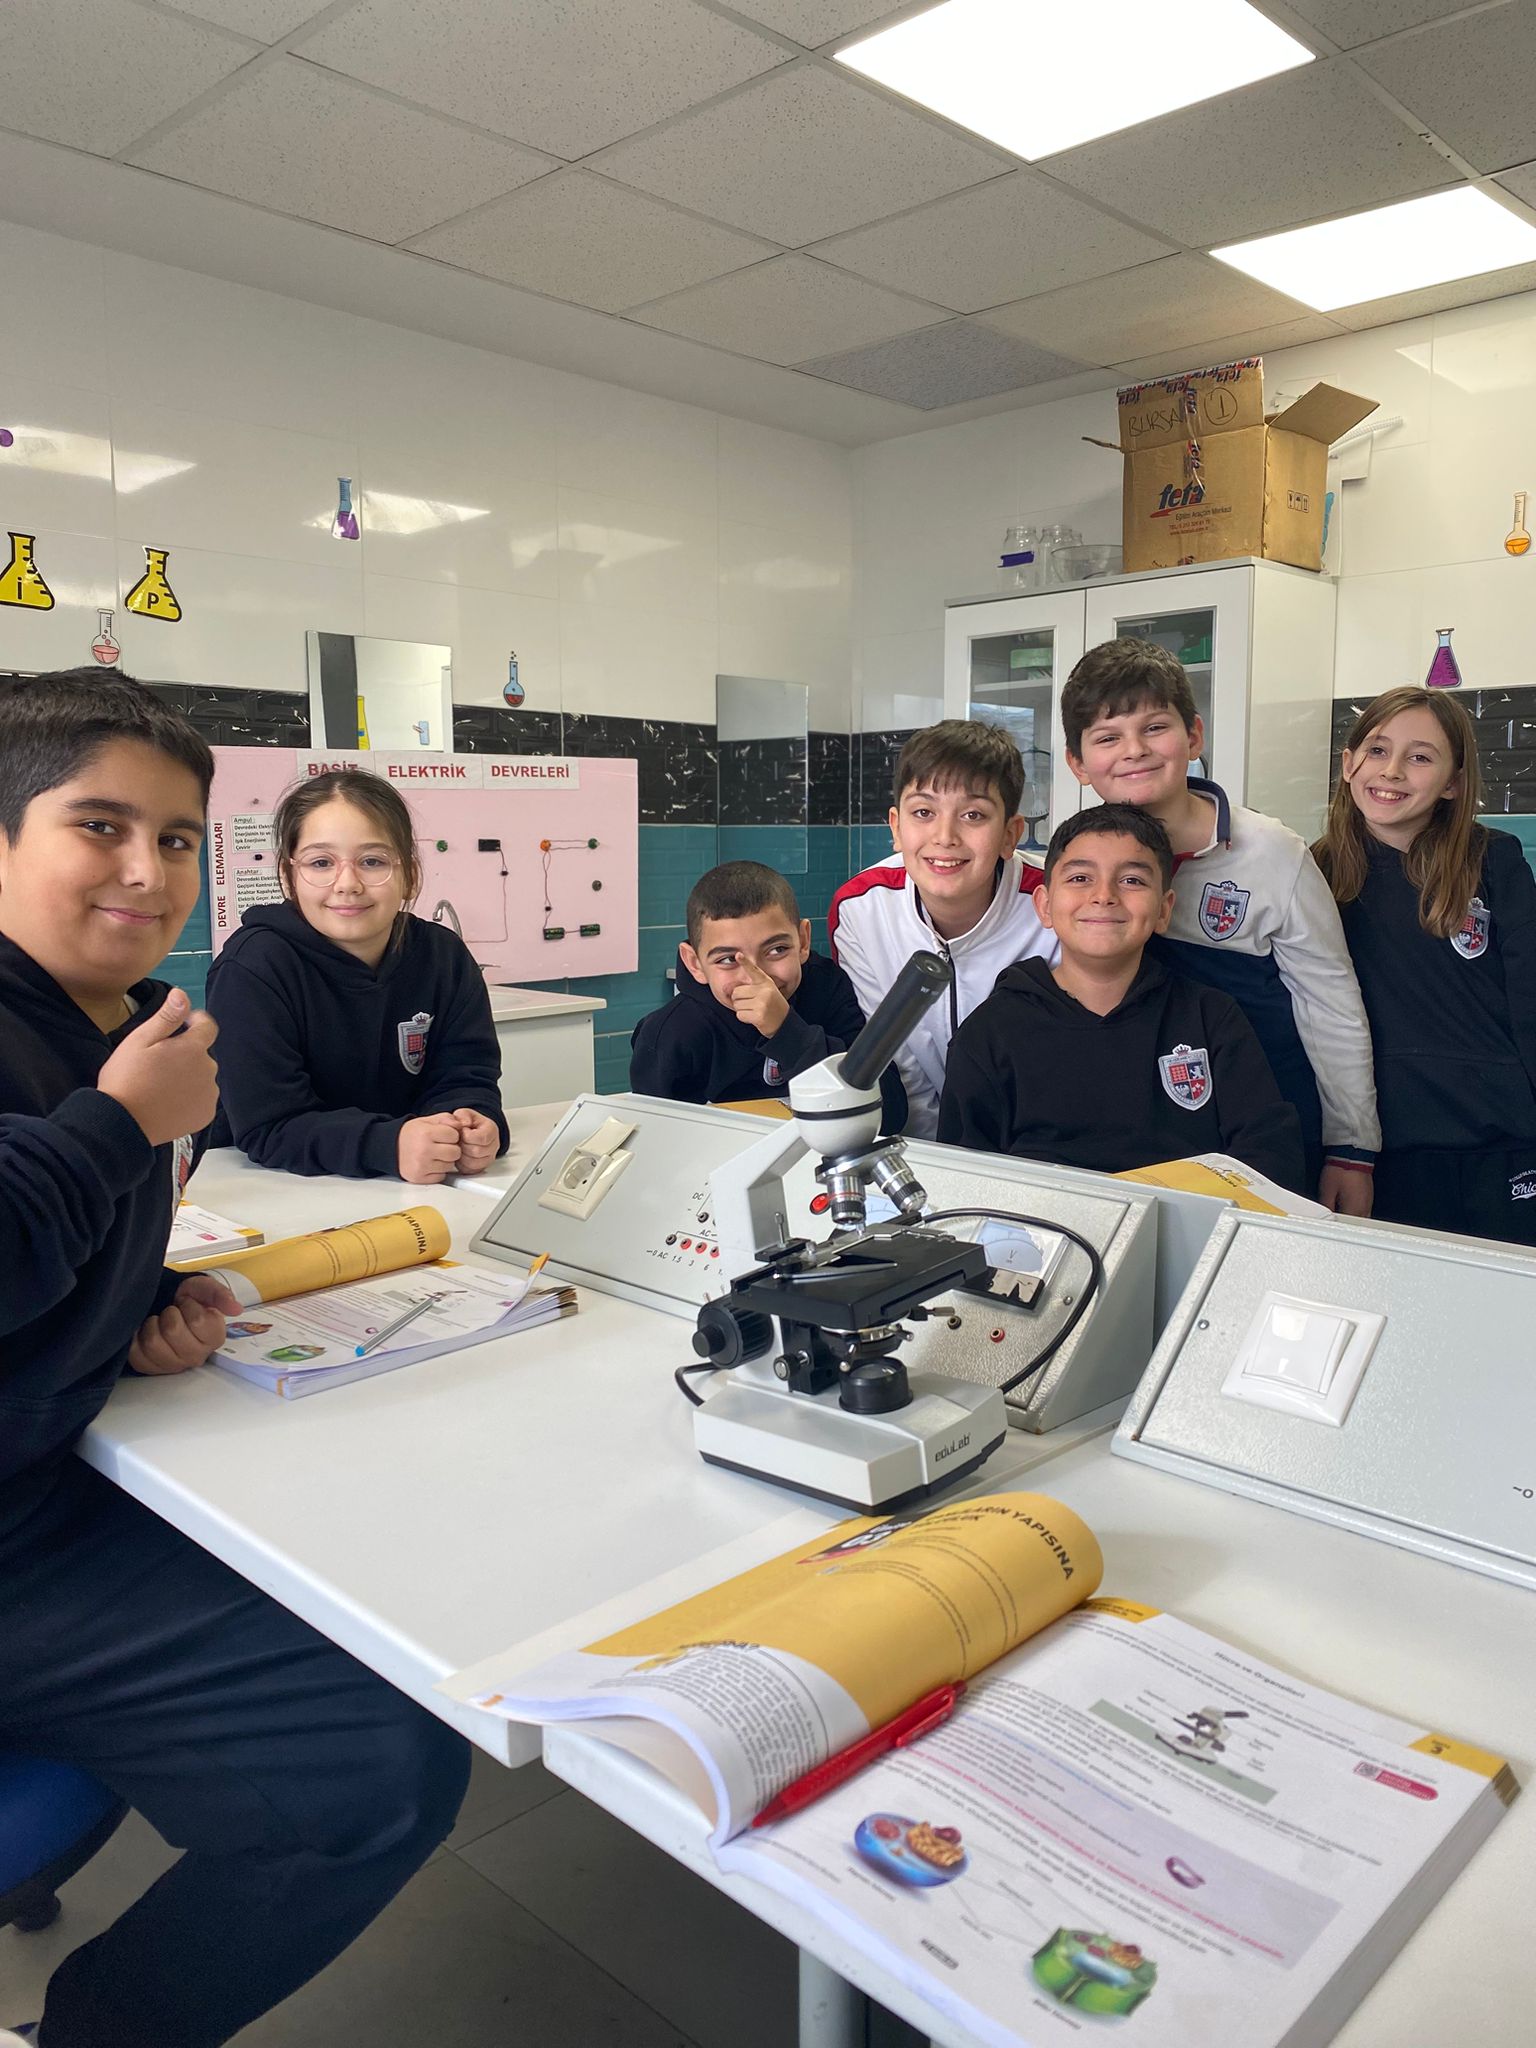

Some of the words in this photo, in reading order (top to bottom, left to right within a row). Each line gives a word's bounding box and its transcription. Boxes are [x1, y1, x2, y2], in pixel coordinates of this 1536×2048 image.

[1128, 407, 1184, 438] BURSA
[147, 592, 160, 610] P
[388, 763, 467, 778] ELEKTRİK
[491, 763, 570, 778] DEVRELERİ
[214, 822, 225, 886] ELEMANLARI
[217, 895, 227, 928] DEVRE
[692, 1192, 704, 1201] DC
[699, 1229, 711, 1237] AC
[658, 1250, 669, 1260] AC
[703, 1263, 710, 1271] 6
[1012, 1511, 1075, 1581] YAPISINA
